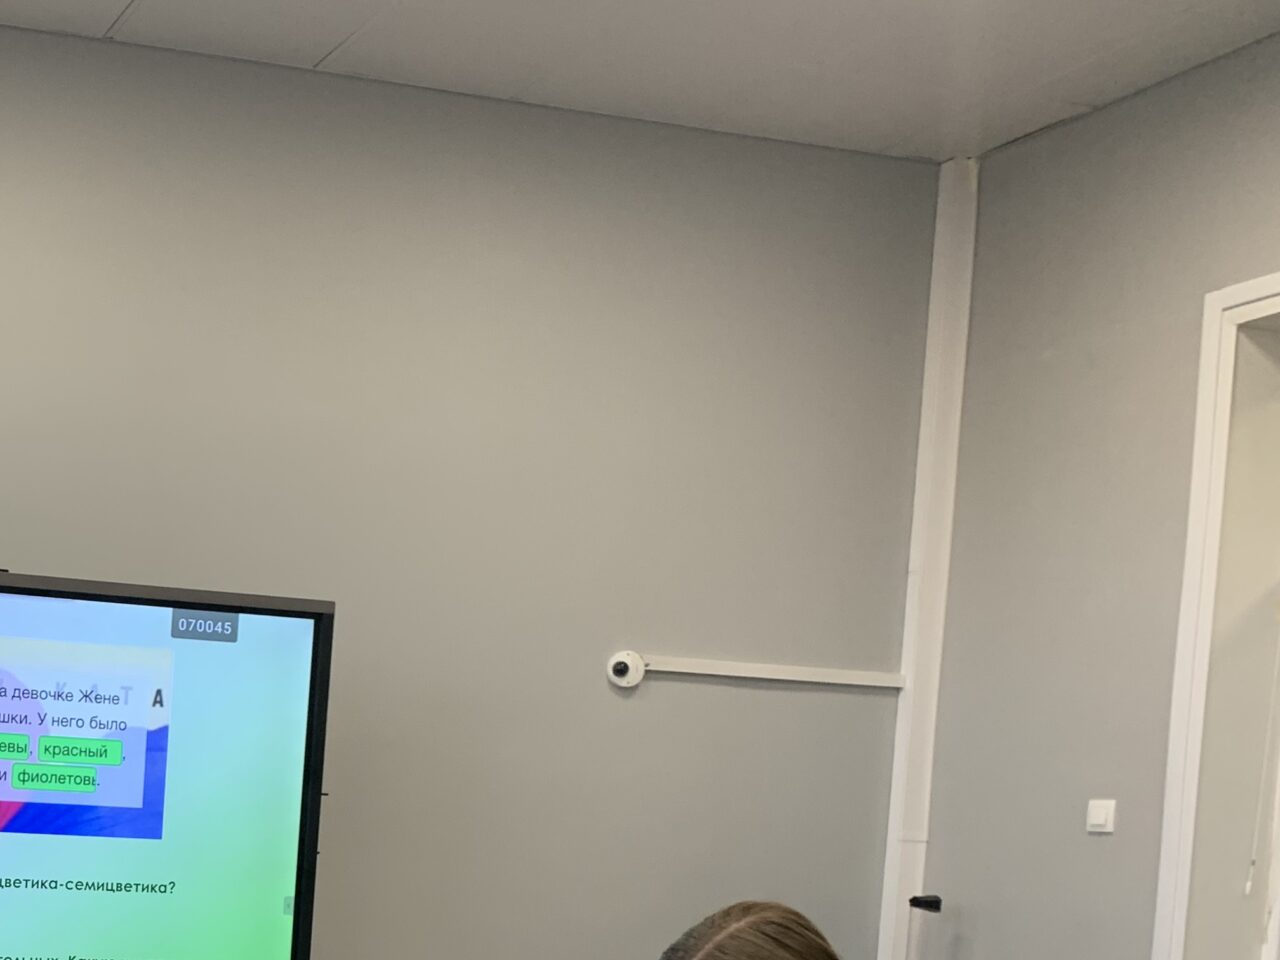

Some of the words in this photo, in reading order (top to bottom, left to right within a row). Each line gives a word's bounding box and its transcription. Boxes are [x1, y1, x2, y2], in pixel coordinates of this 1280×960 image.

[178, 618, 232, 634] 070045
[11, 686, 73, 702] девочке
[78, 688, 120, 705] Жене
[37, 712, 47, 726] У
[51, 716, 84, 729] него
[89, 716, 127, 731] было
